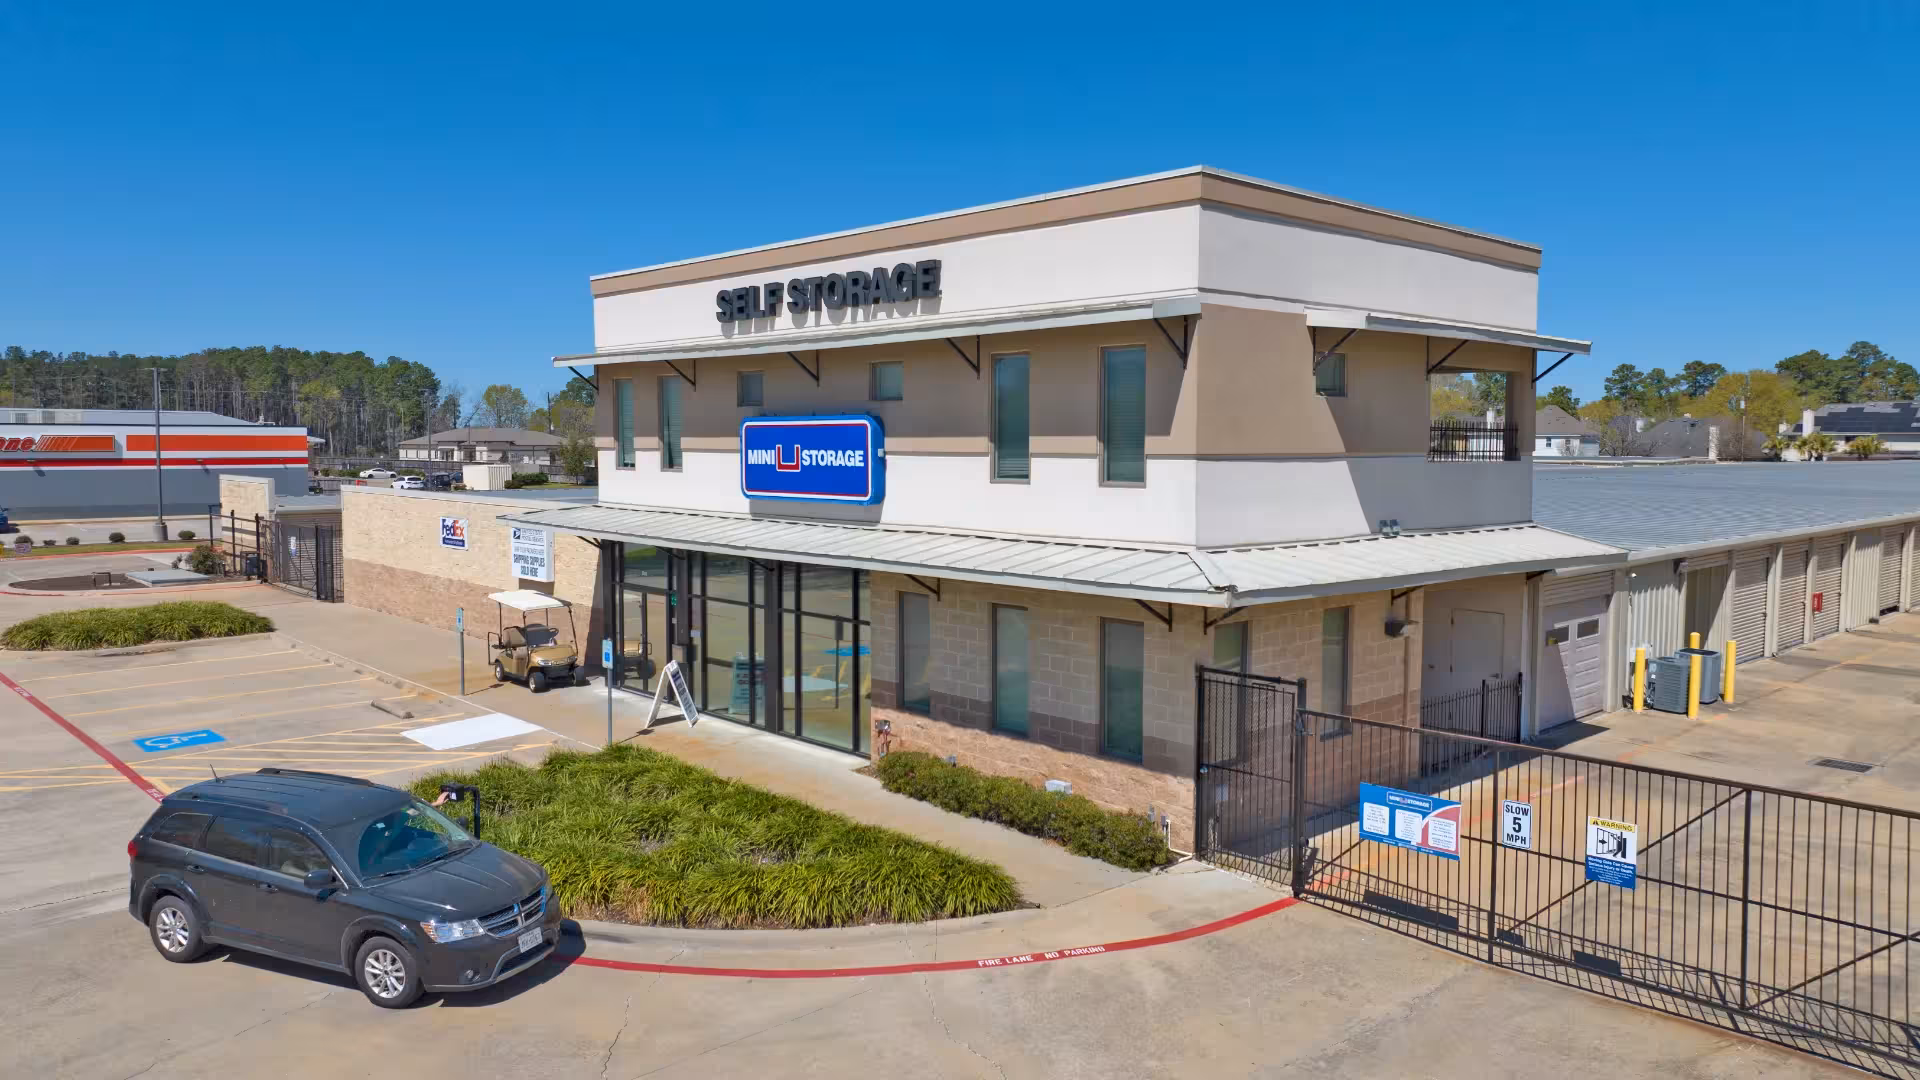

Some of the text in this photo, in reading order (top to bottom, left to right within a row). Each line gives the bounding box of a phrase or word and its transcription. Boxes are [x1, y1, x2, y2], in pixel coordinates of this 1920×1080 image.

[716, 259, 942, 323] SELF STORAGE
[748, 450, 775, 465] MINI
[801, 449, 865, 467] STORAGE
[441, 519, 464, 538] FedEx
[514, 554, 545, 568] SHIPPING SUPPLIES
[520, 565, 539, 577] SOLD HERE
[1505, 804, 1530, 816] SLOW
[1512, 817, 1521, 833] 5
[1600, 820, 1633, 832] WARNING
[1506, 833, 1526, 845] MPH
[978, 946, 1106, 967] FIRE LANE NO PARKING
